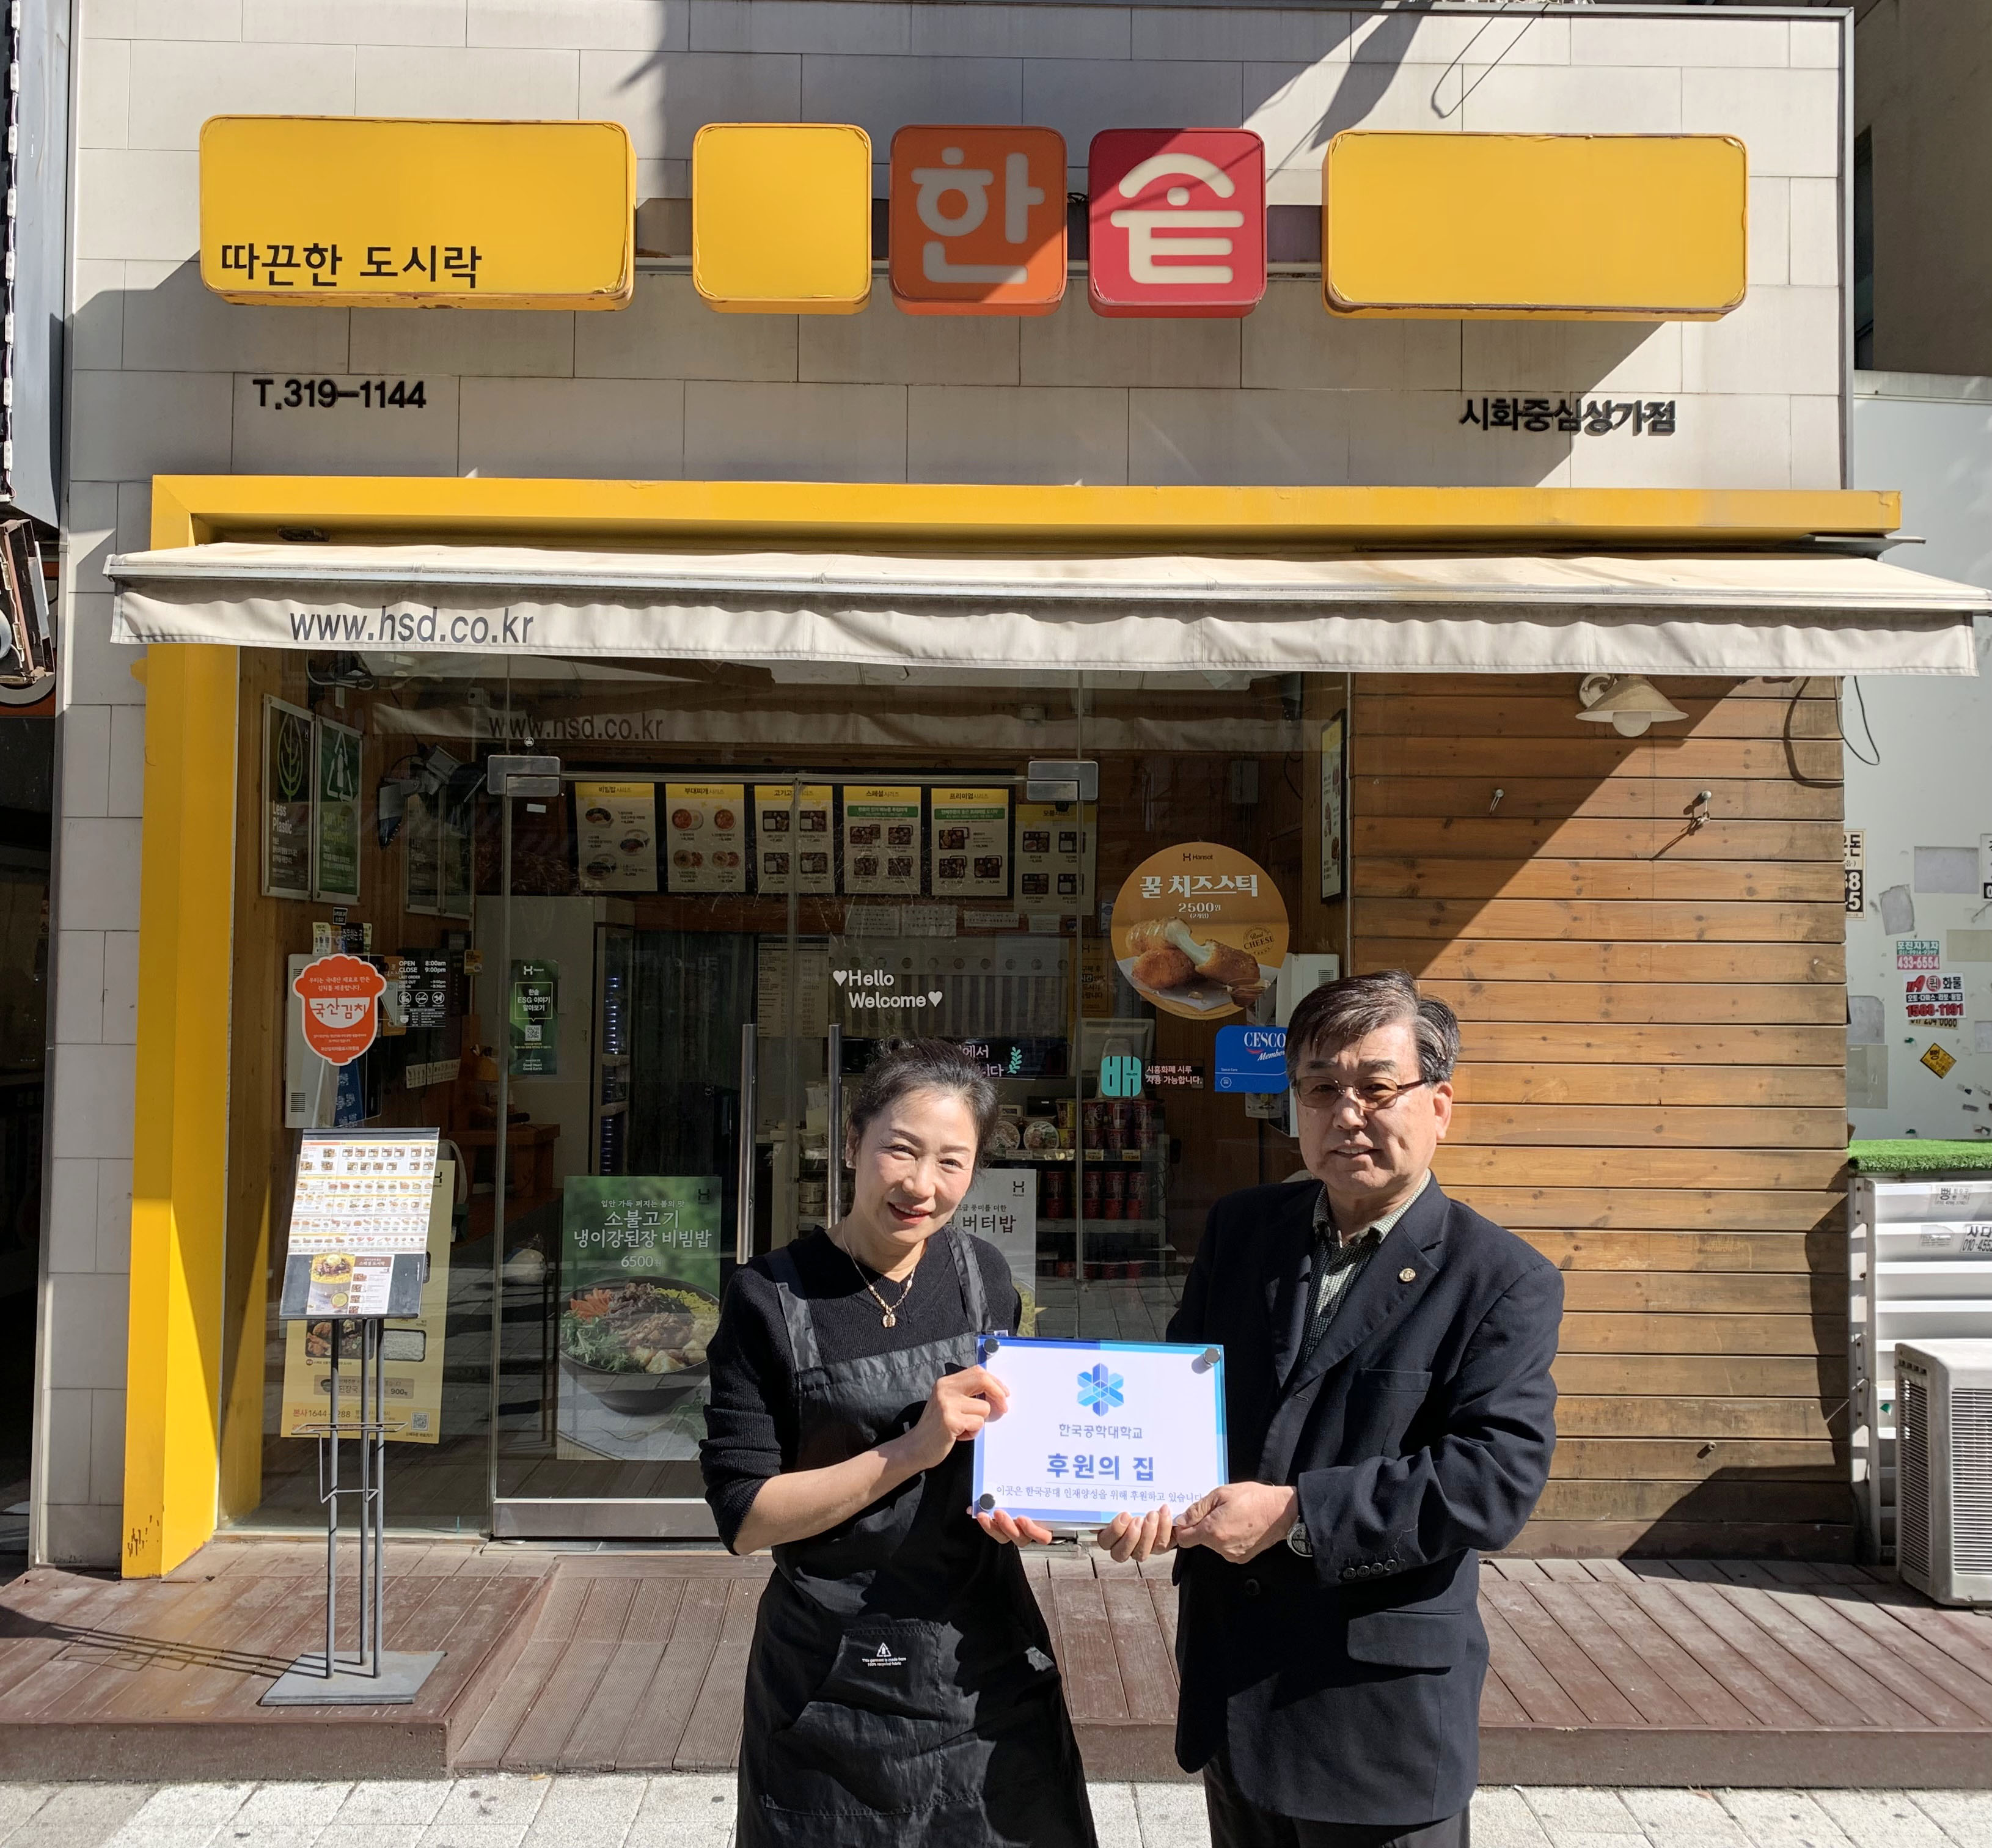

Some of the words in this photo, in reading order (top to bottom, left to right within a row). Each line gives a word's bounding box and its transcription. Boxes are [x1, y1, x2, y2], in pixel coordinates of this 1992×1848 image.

[221, 243, 342, 287] 따끈한
[359, 246, 482, 288] 도시락
[252, 379, 427, 410] T.319-1144
[1459, 398, 1676, 434] 시화중심상가점
[290, 606, 534, 644] www.hsd.co.kr
[273, 801, 287, 816] Less
[273, 817, 293, 835] Plastic
[1140, 876, 1163, 899] 꿀
[1168, 875, 1258, 898] 치즈스틱
[1845, 871, 1861, 890] 8
[1178, 902, 1221, 913] 2500원
[1243, 936, 1275, 950] CHEESE
[1898, 956, 1939, 969] 433-6554
[848, 969, 895, 986] Hello
[1943, 977, 1962, 989] 화물
[848, 991, 927, 1008] Welcome
[311, 998, 367, 1019] 국산김치
[1244, 1032, 1286, 1047] CESCO
[959, 1044, 989, 1058] 에서
[1146, 1065, 1176, 1074] 시흥화폐
[1177, 1065, 1192, 1074] 시루
[1146, 1076, 1162, 1085] 사용
[1163, 1076, 1203, 1085] 가능합니다.
[604, 1209, 679, 1228] 소불고기
[962, 1215, 1016, 1233] 버터밥
[574, 1229, 657, 1248] 냉이강된장
[662, 1229, 712, 1248] 비빔밥
[1962, 1239, 1992, 1252] 010-455
[621, 1255, 661, 1267] 6500원
[1058, 1423, 1143, 1439] 한국공학대학교
[1047, 1453, 1119, 1480] 후원의
[1132, 1456, 1154, 1481] 집
[997, 1486, 1023, 1497] 이곳은
[1025, 1487, 1060, 1498] 한국공대
[1064, 1488, 1107, 1500] 인재양성을
[1110, 1490, 1128, 1501] 위해
[1130, 1492, 1165, 1502] 후원하고
